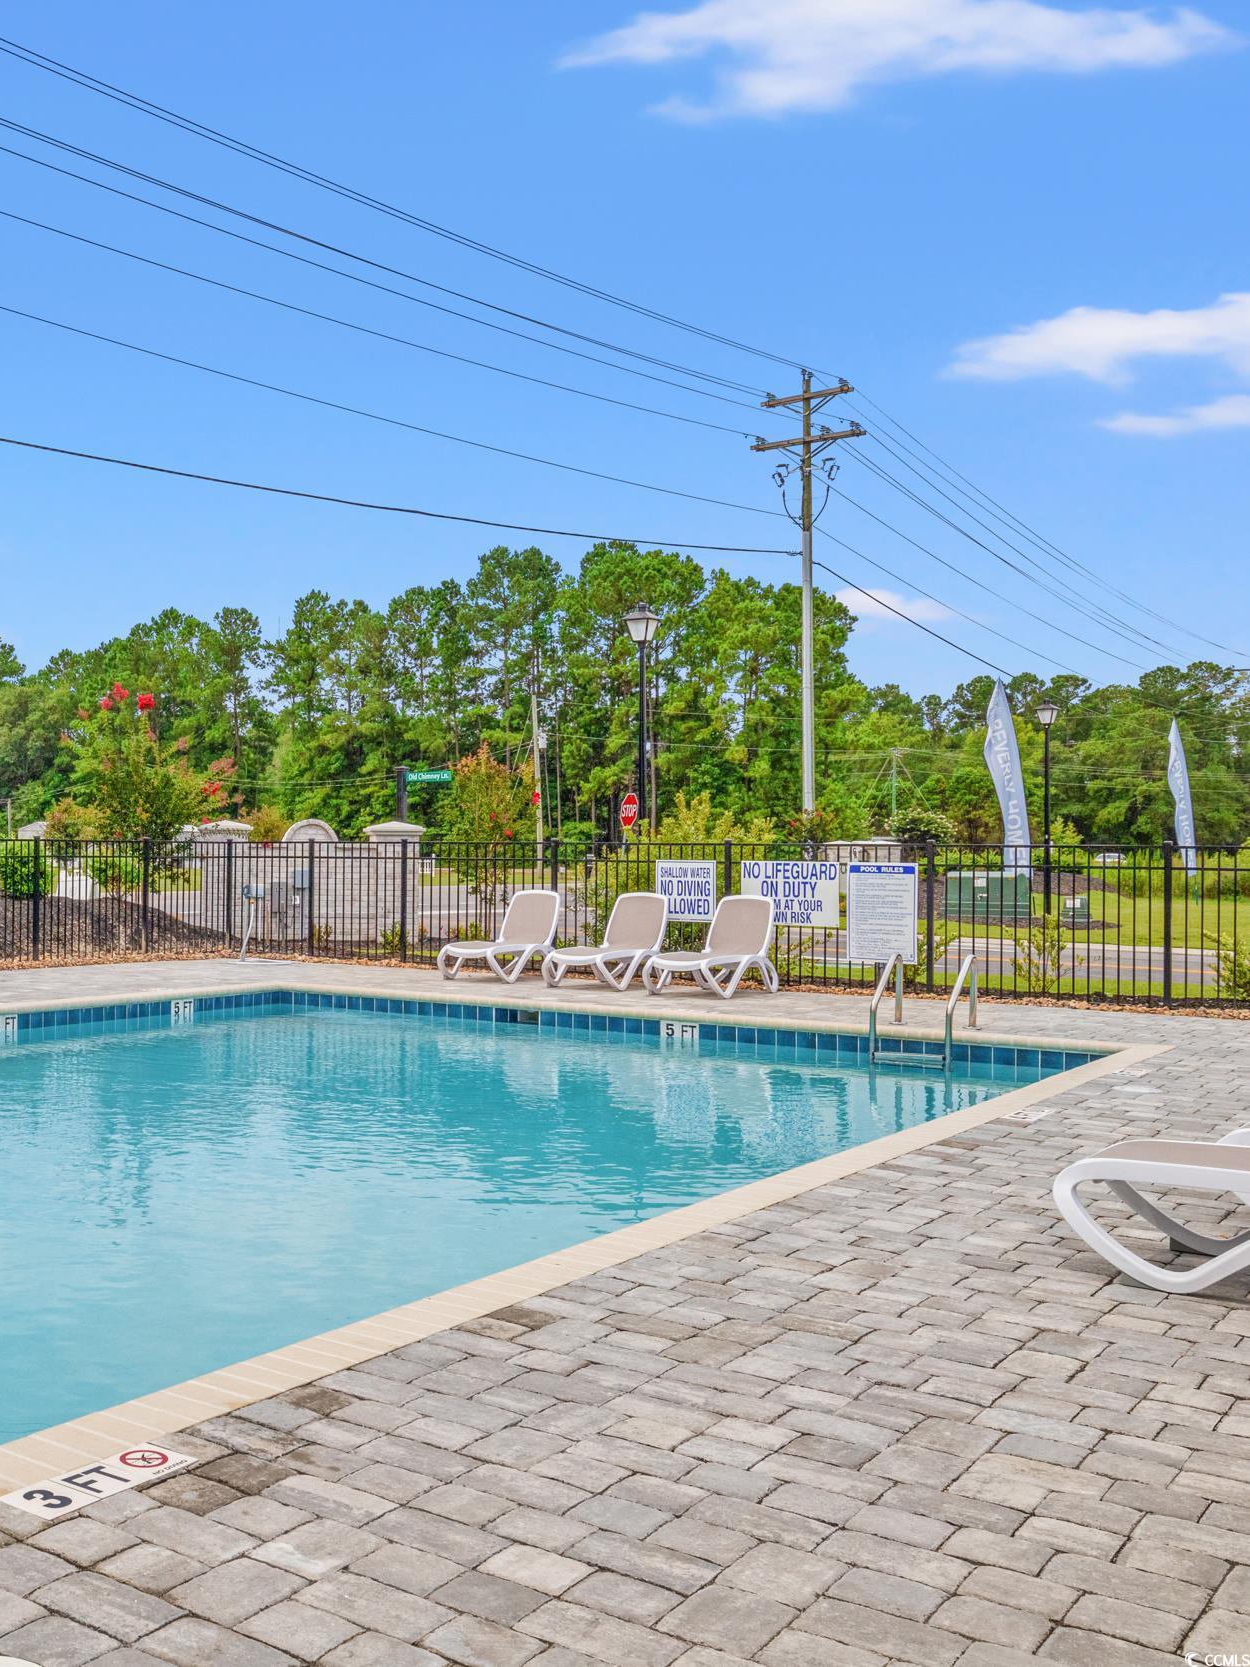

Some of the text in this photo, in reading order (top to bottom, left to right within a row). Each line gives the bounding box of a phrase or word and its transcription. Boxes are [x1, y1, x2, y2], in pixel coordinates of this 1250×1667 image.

[408, 772, 418, 781] Old
[418, 772, 440, 781] Chimney
[621, 804, 637, 817] STOP
[660, 866, 711, 879] SHALLOW WATER
[743, 861, 838, 881] NO LIFEGUARD
[660, 879, 711, 897] NO DIVING
[761, 880, 818, 899] ON DUTY
[667, 897, 710, 915] LLOWED
[783, 899, 795, 911] AT
[797, 899, 823, 912] YOUR
[773, 911, 812, 924] WN RISK
[174, 1000, 193, 1017] 5 FT
[5, 1016, 17, 1032] FT
[666, 1023, 697, 1039] 5 FT
[22, 1465, 131, 1509] 3 FT
